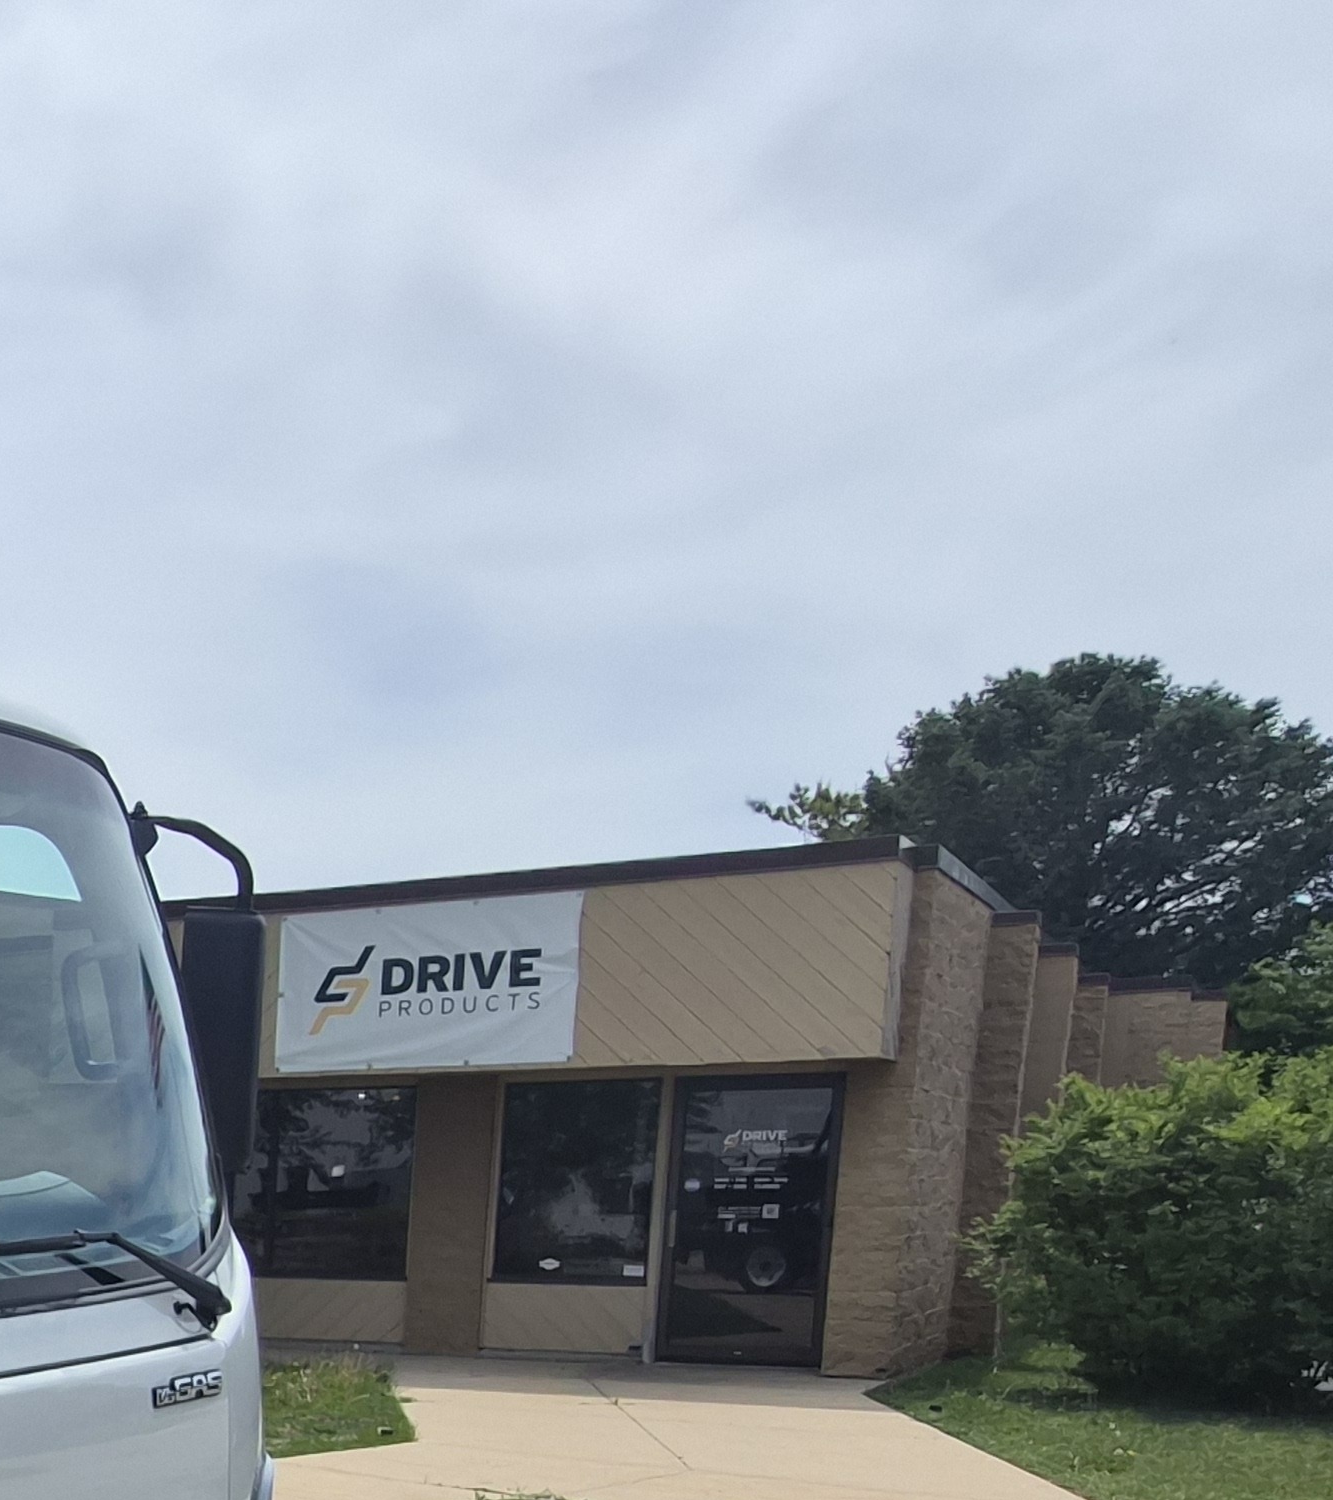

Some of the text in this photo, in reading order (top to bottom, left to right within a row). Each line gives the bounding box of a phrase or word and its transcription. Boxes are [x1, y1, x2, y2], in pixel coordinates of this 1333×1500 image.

[380, 948, 542, 996] DRIVE
[378, 991, 541, 1018] PRODUCTS
[741, 1129, 788, 1141] DRIVE
